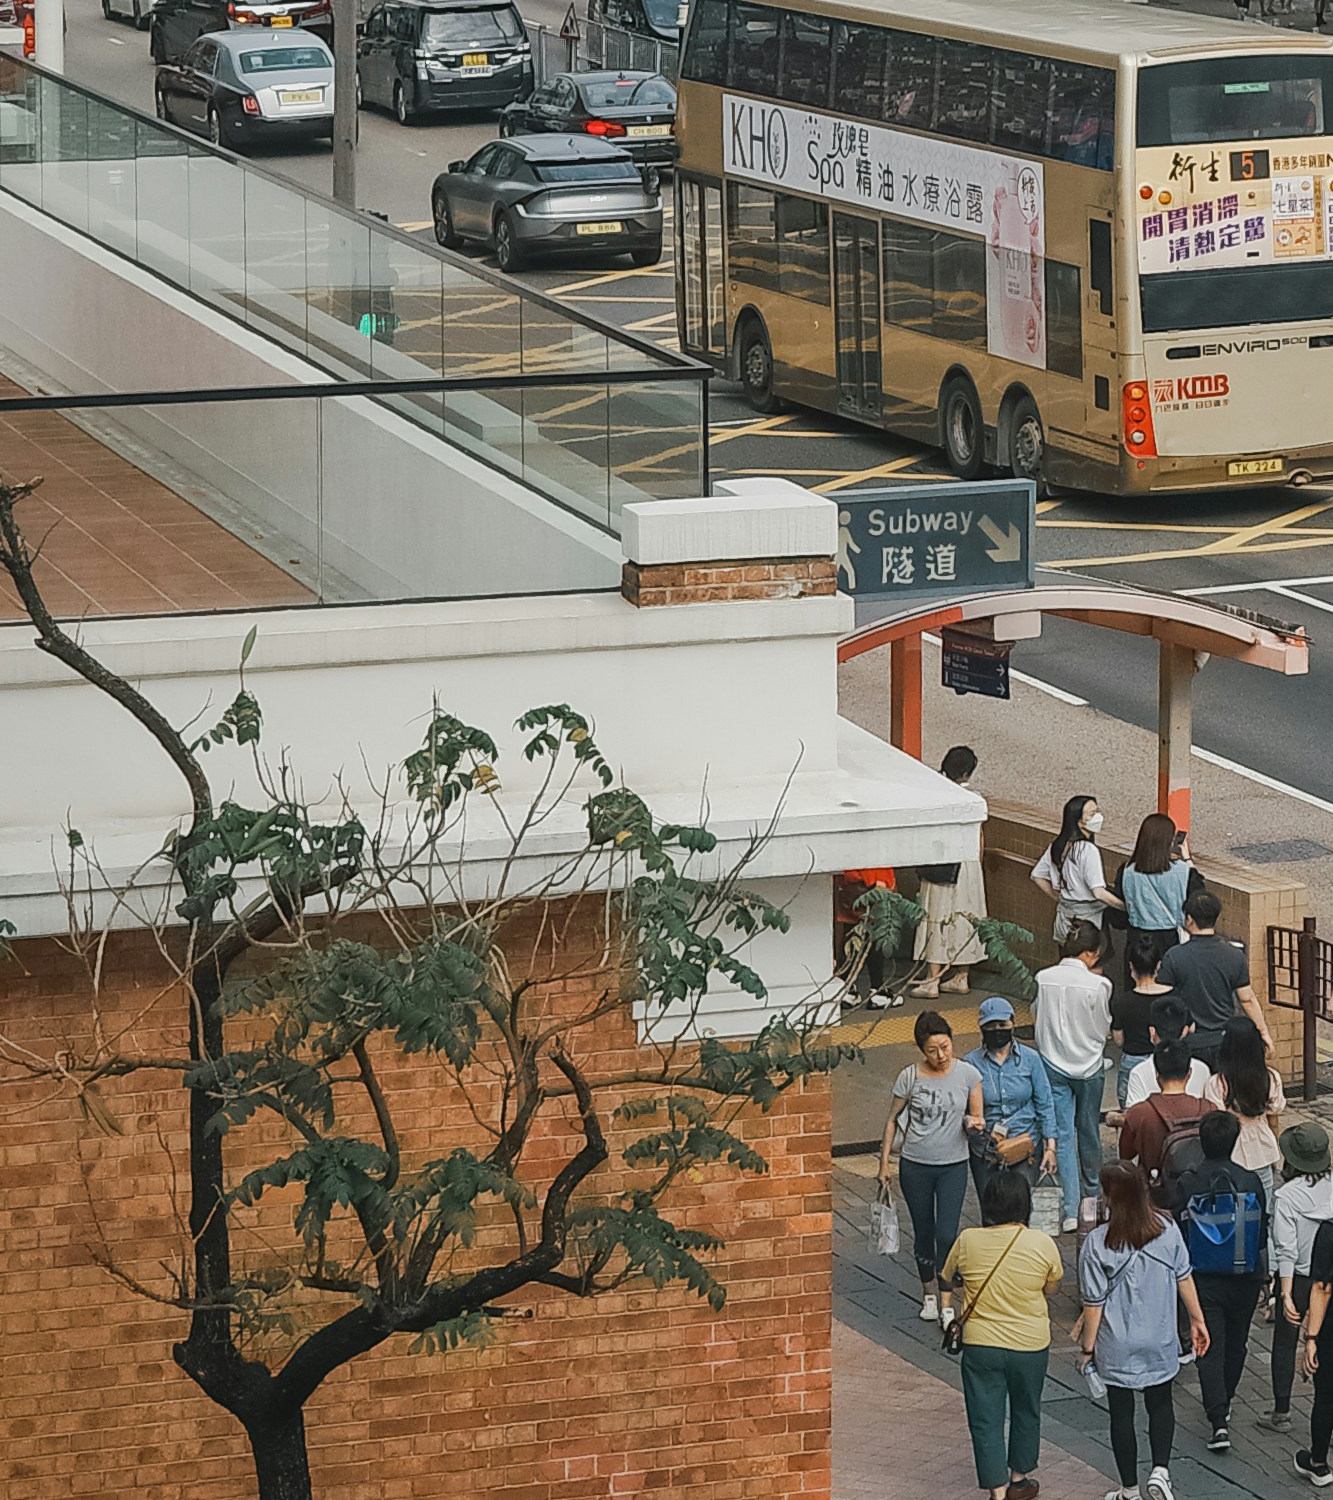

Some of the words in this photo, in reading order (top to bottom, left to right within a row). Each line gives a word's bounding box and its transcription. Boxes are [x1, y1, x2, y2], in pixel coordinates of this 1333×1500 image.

[730, 102, 788, 180] KHO
[807, 139, 845, 193] Spa
[1241, 152, 1254, 179] 5
[1177, 374, 1230, 401] KMB
[1235, 463, 1250, 474] TK
[1255, 461, 1277, 472] 224
[868, 508, 974, 537] Subway
[881, 552, 958, 585] 隧道
